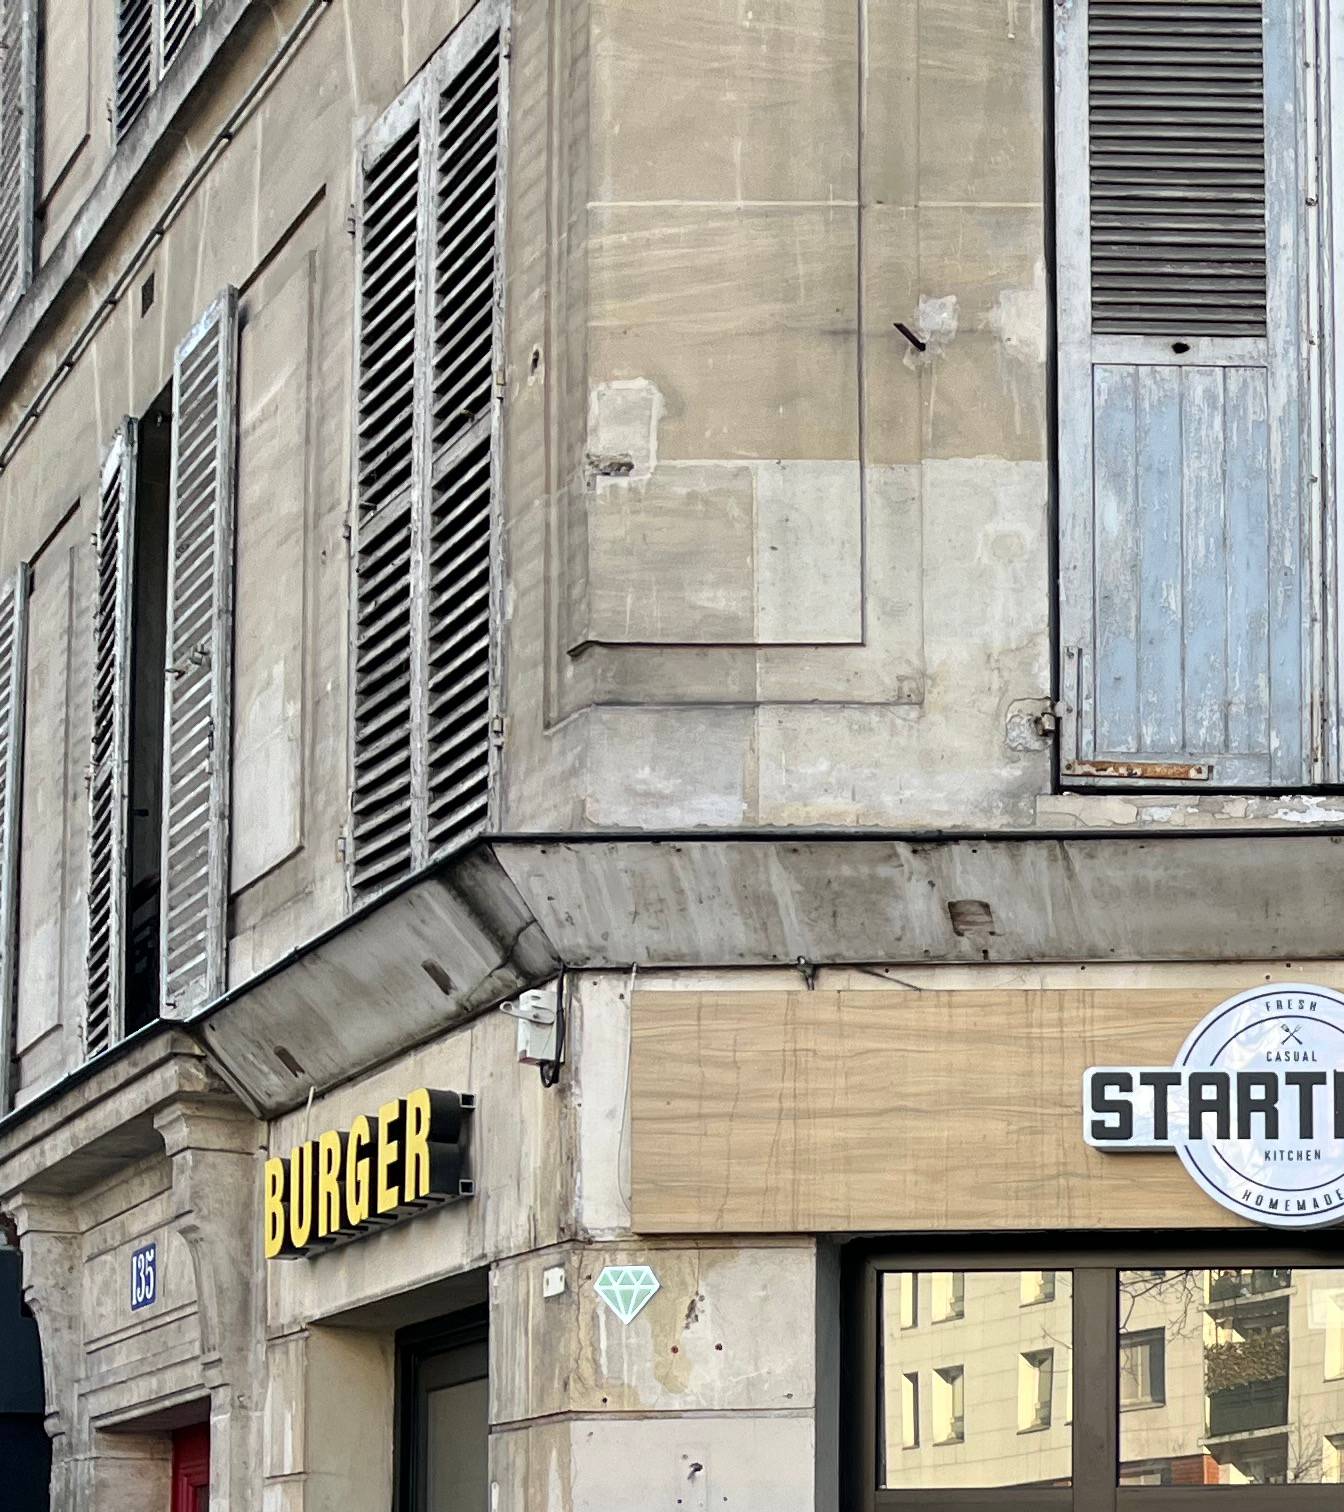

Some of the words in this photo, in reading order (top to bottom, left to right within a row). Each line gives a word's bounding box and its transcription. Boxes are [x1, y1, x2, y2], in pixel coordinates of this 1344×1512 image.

[1265, 998, 1318, 1012] FRESH
[1265, 1049, 1318, 1063] CASUAL
[1264, 1149, 1322, 1162] KITCHEN
[264, 1087, 431, 1259] BURGER
[132, 1249, 155, 1305] 135
